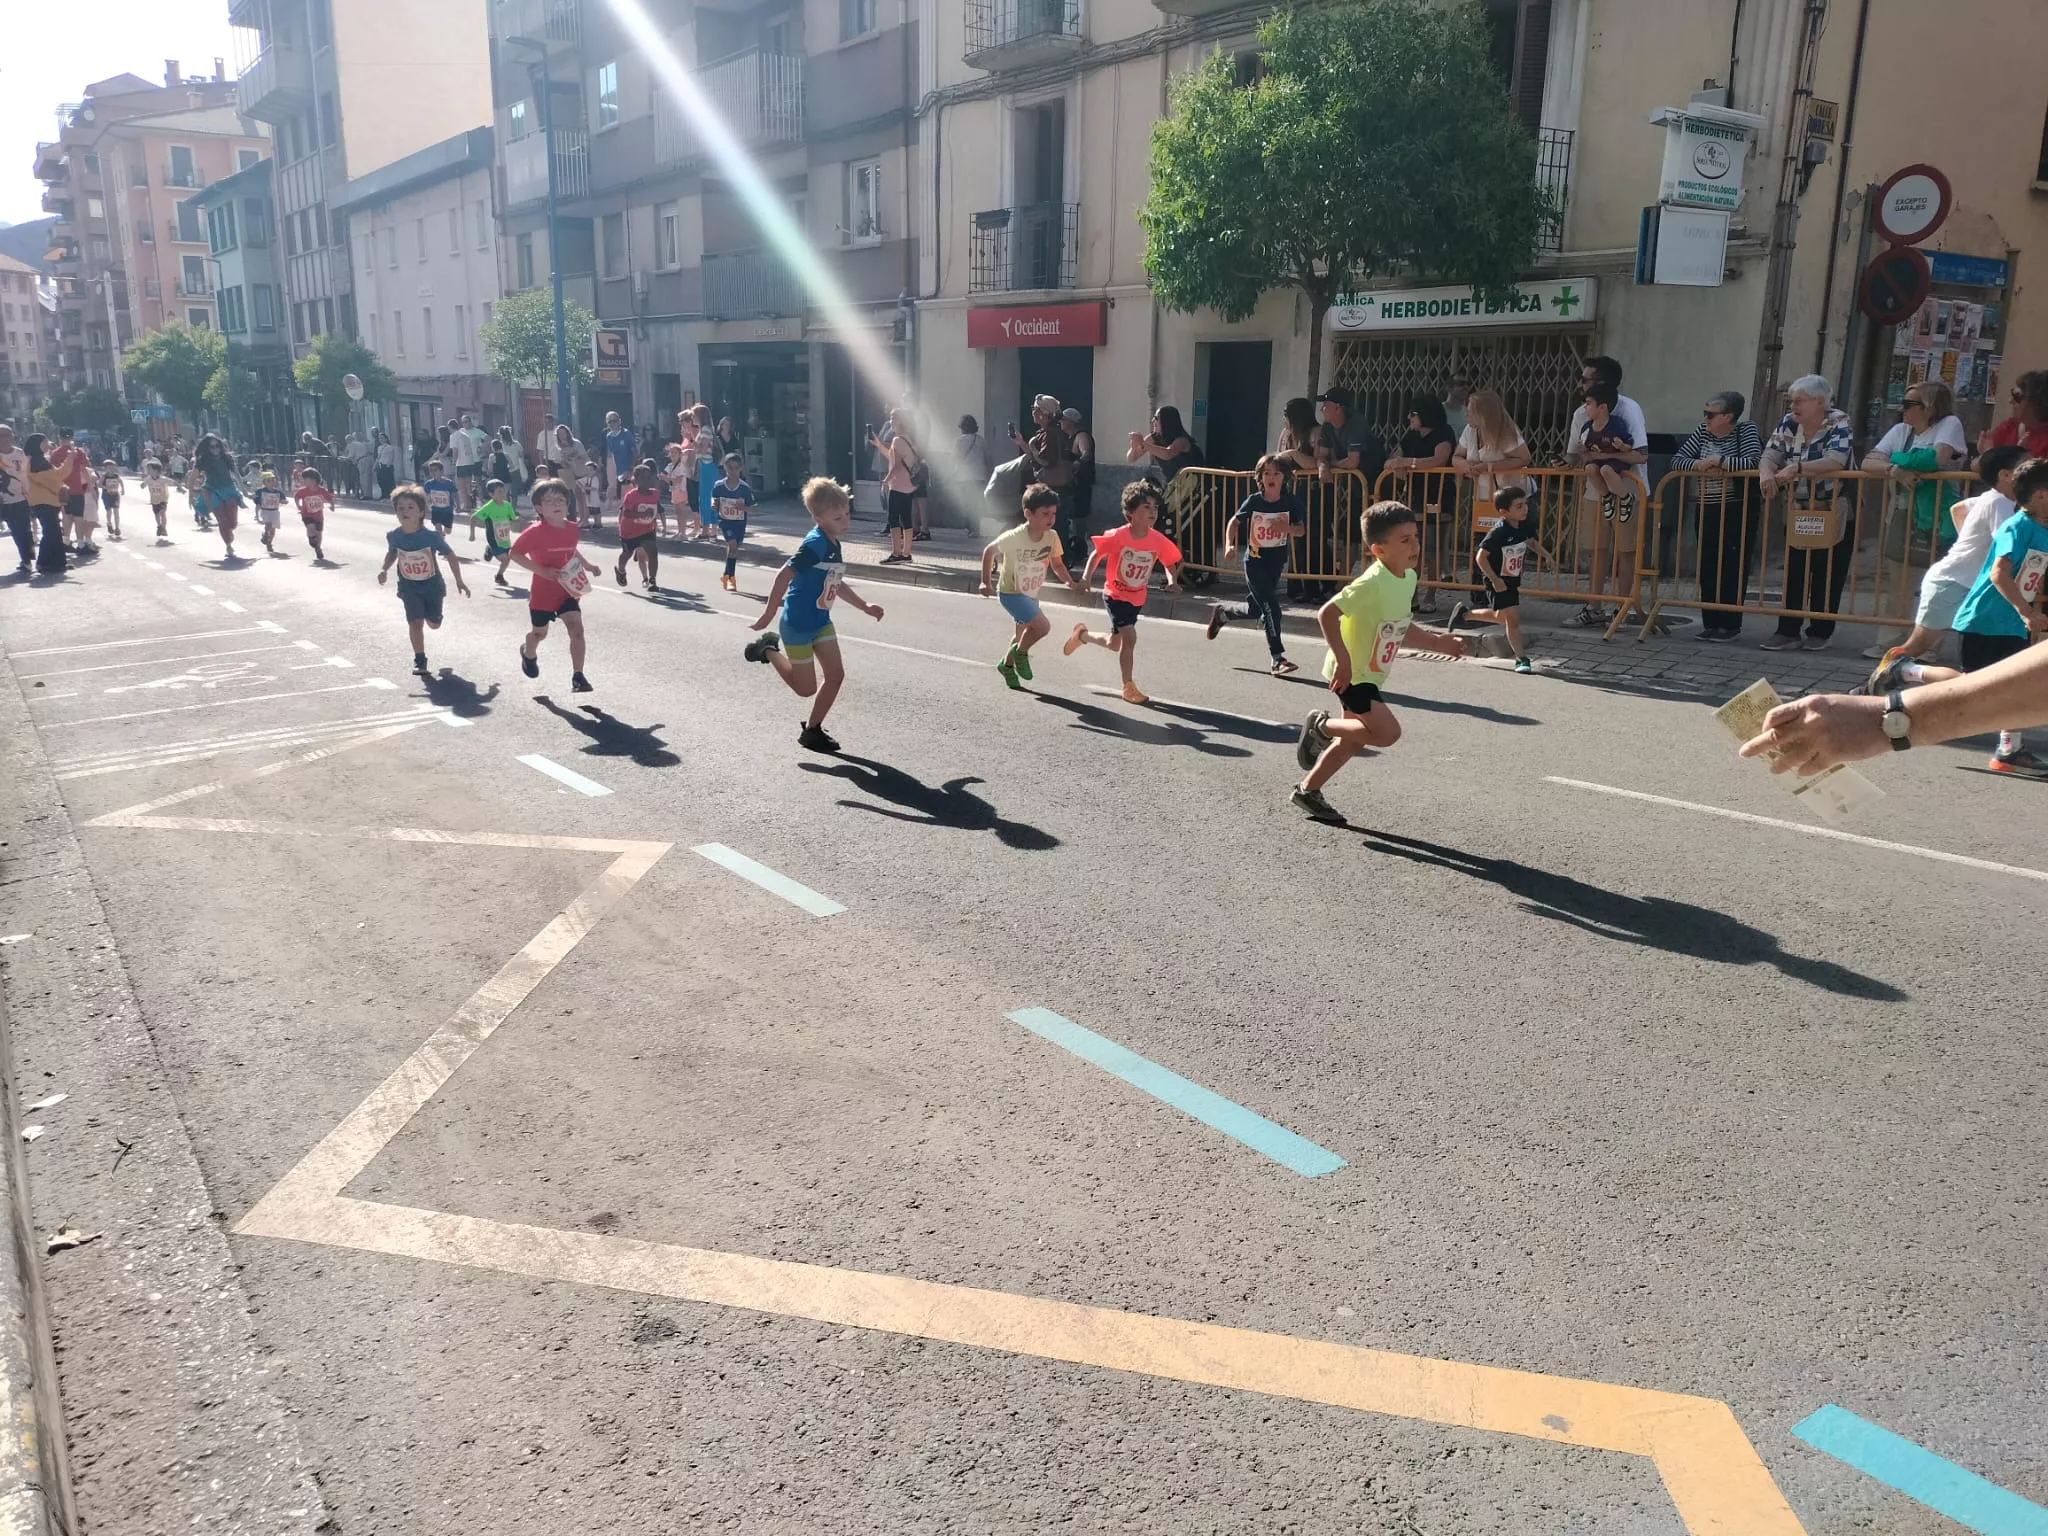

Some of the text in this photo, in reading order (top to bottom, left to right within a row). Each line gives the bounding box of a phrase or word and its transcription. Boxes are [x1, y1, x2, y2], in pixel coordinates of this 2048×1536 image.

[1679, 180, 1707, 193] PRODUCTOS
[1714, 196, 1735, 206] NATURAL
[1896, 197, 1928, 205] EXCEPTO
[1895, 204, 1926, 212] GARAJES
[1331, 297, 1375, 307] ARNICA
[1014, 318, 1060, 336] Occident
[404, 561, 429, 576] 362
